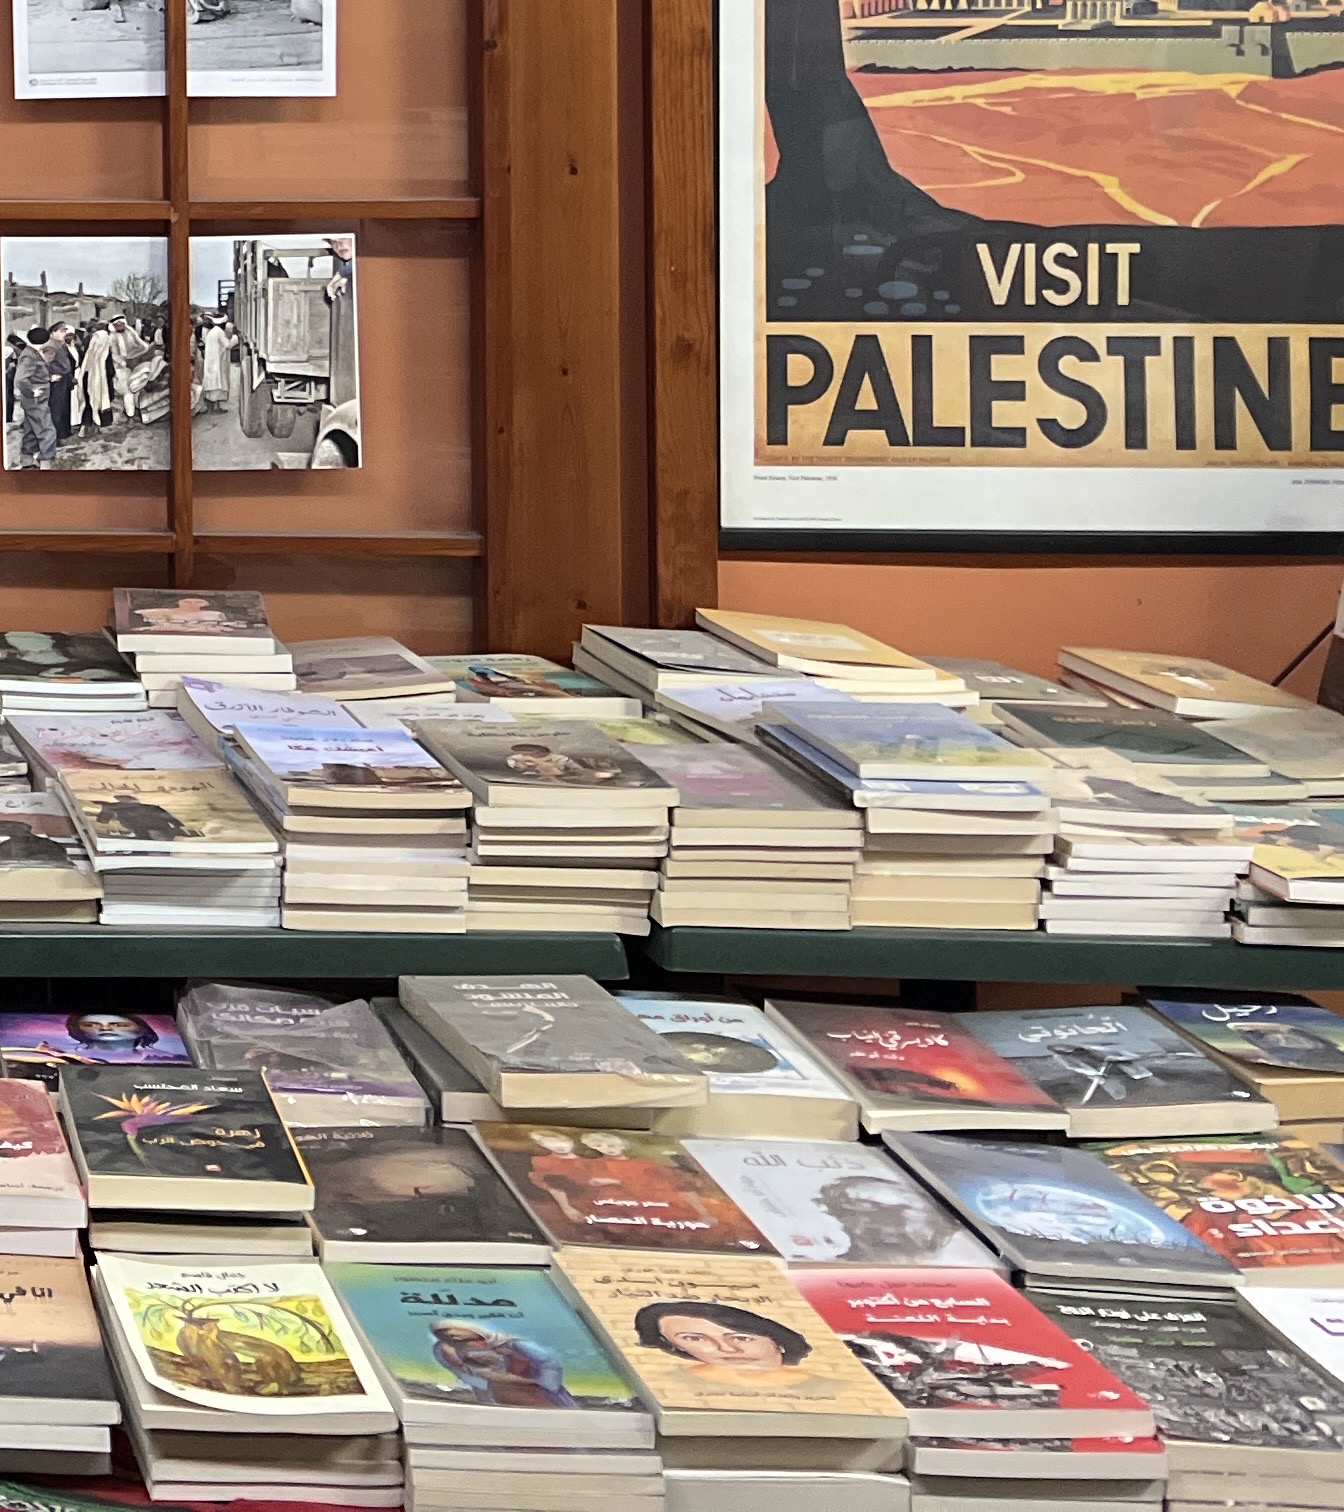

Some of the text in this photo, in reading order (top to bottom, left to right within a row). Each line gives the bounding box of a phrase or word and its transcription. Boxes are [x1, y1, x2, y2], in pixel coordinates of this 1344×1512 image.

[976, 242, 1141, 307] VISIT
[765, 334, 1344, 453] PALESTINE
[214, 1126, 261, 1138] زهرة
[243, 1139, 266, 1150] في
[742, 1150, 788, 1168] الله
[0, 1285, 28, 1304] في
[266, 1280, 280, 1294] لا
[847, 1292, 991, 1309] السابع من أكتوبر
[866, 1312, 1012, 1327] بداية اللعنة
